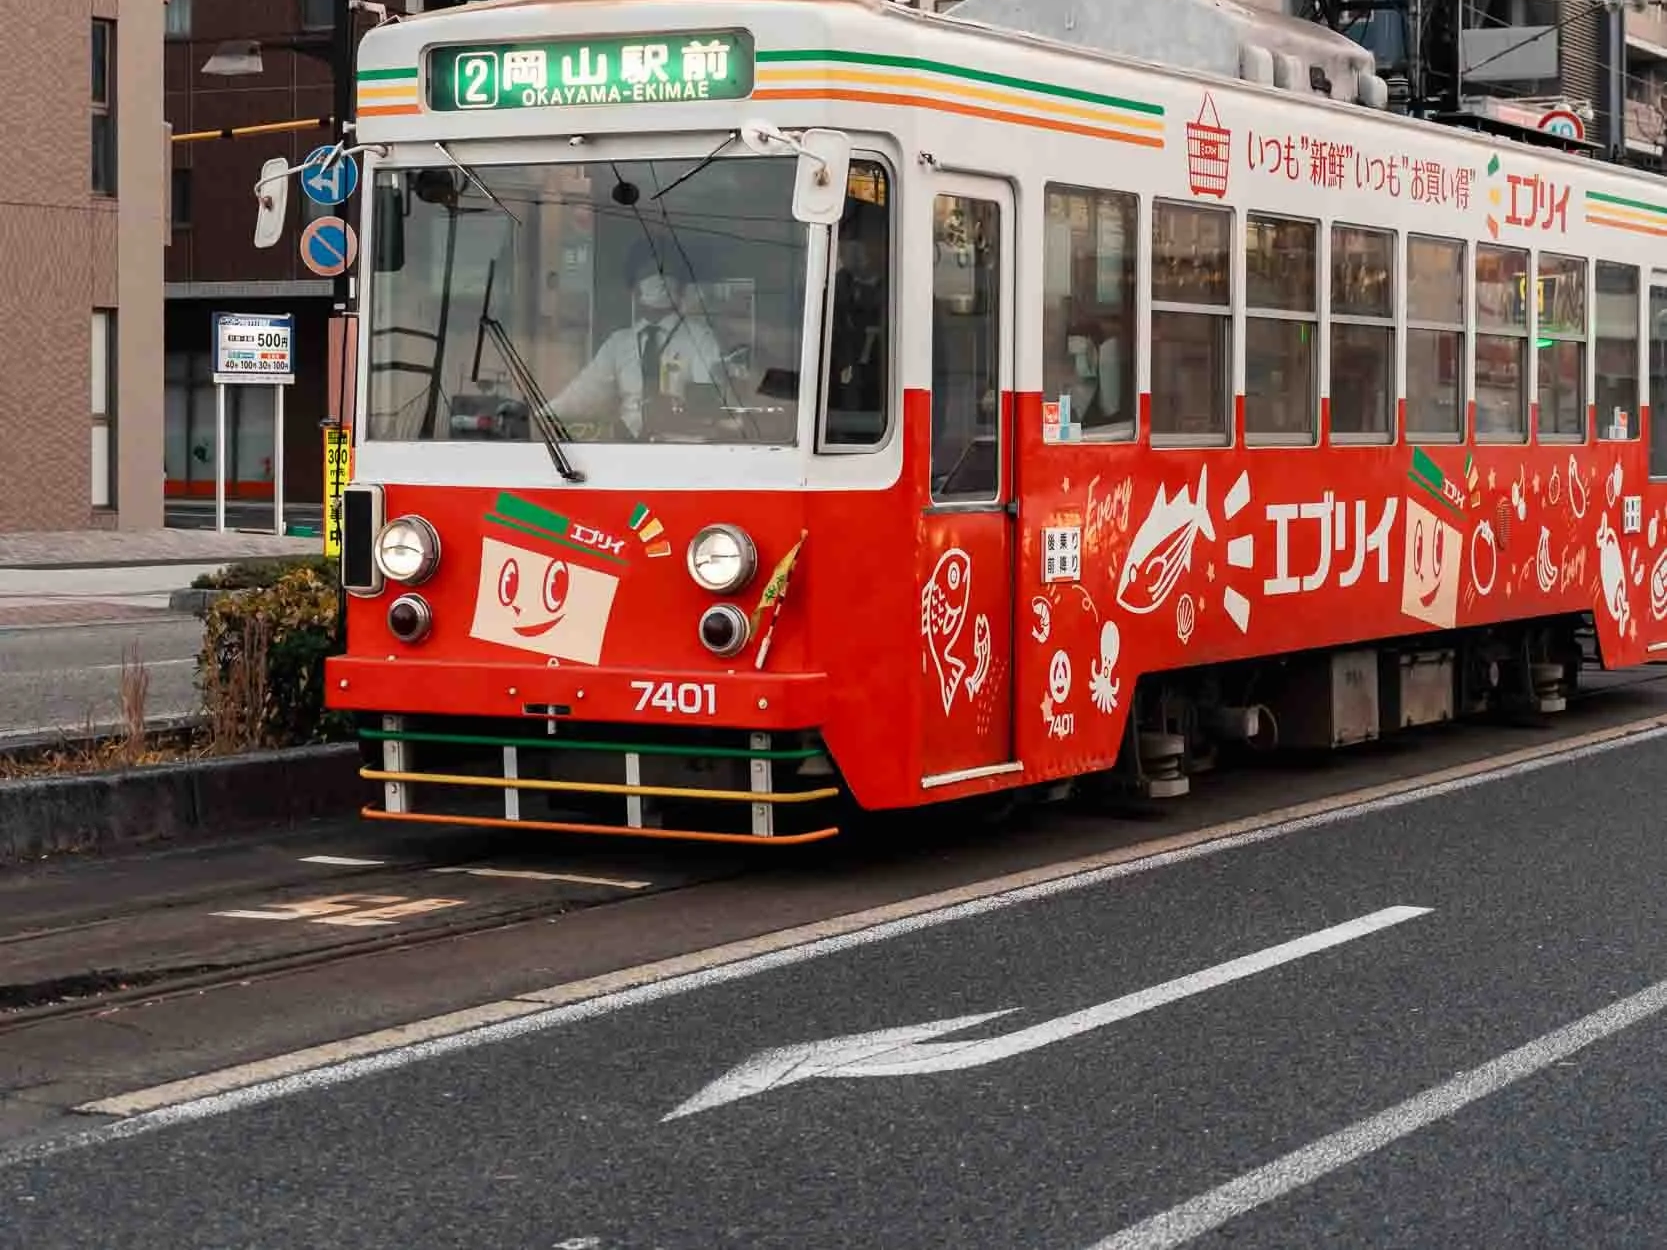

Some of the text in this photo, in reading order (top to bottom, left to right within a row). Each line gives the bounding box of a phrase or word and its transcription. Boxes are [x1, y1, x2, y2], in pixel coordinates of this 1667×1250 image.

[465, 40, 730, 101] 2 岡山駅前
[522, 81, 710, 106] OKAYAMA-EKIMAE
[1505, 174, 1571, 233] エブリイ
[1083, 475, 1132, 549] Every
[570, 524, 625, 554] エブリイ
[1264, 491, 1398, 595] エブリイ
[630, 681, 716, 715] 7401
[1047, 713, 1074, 739] 7401
